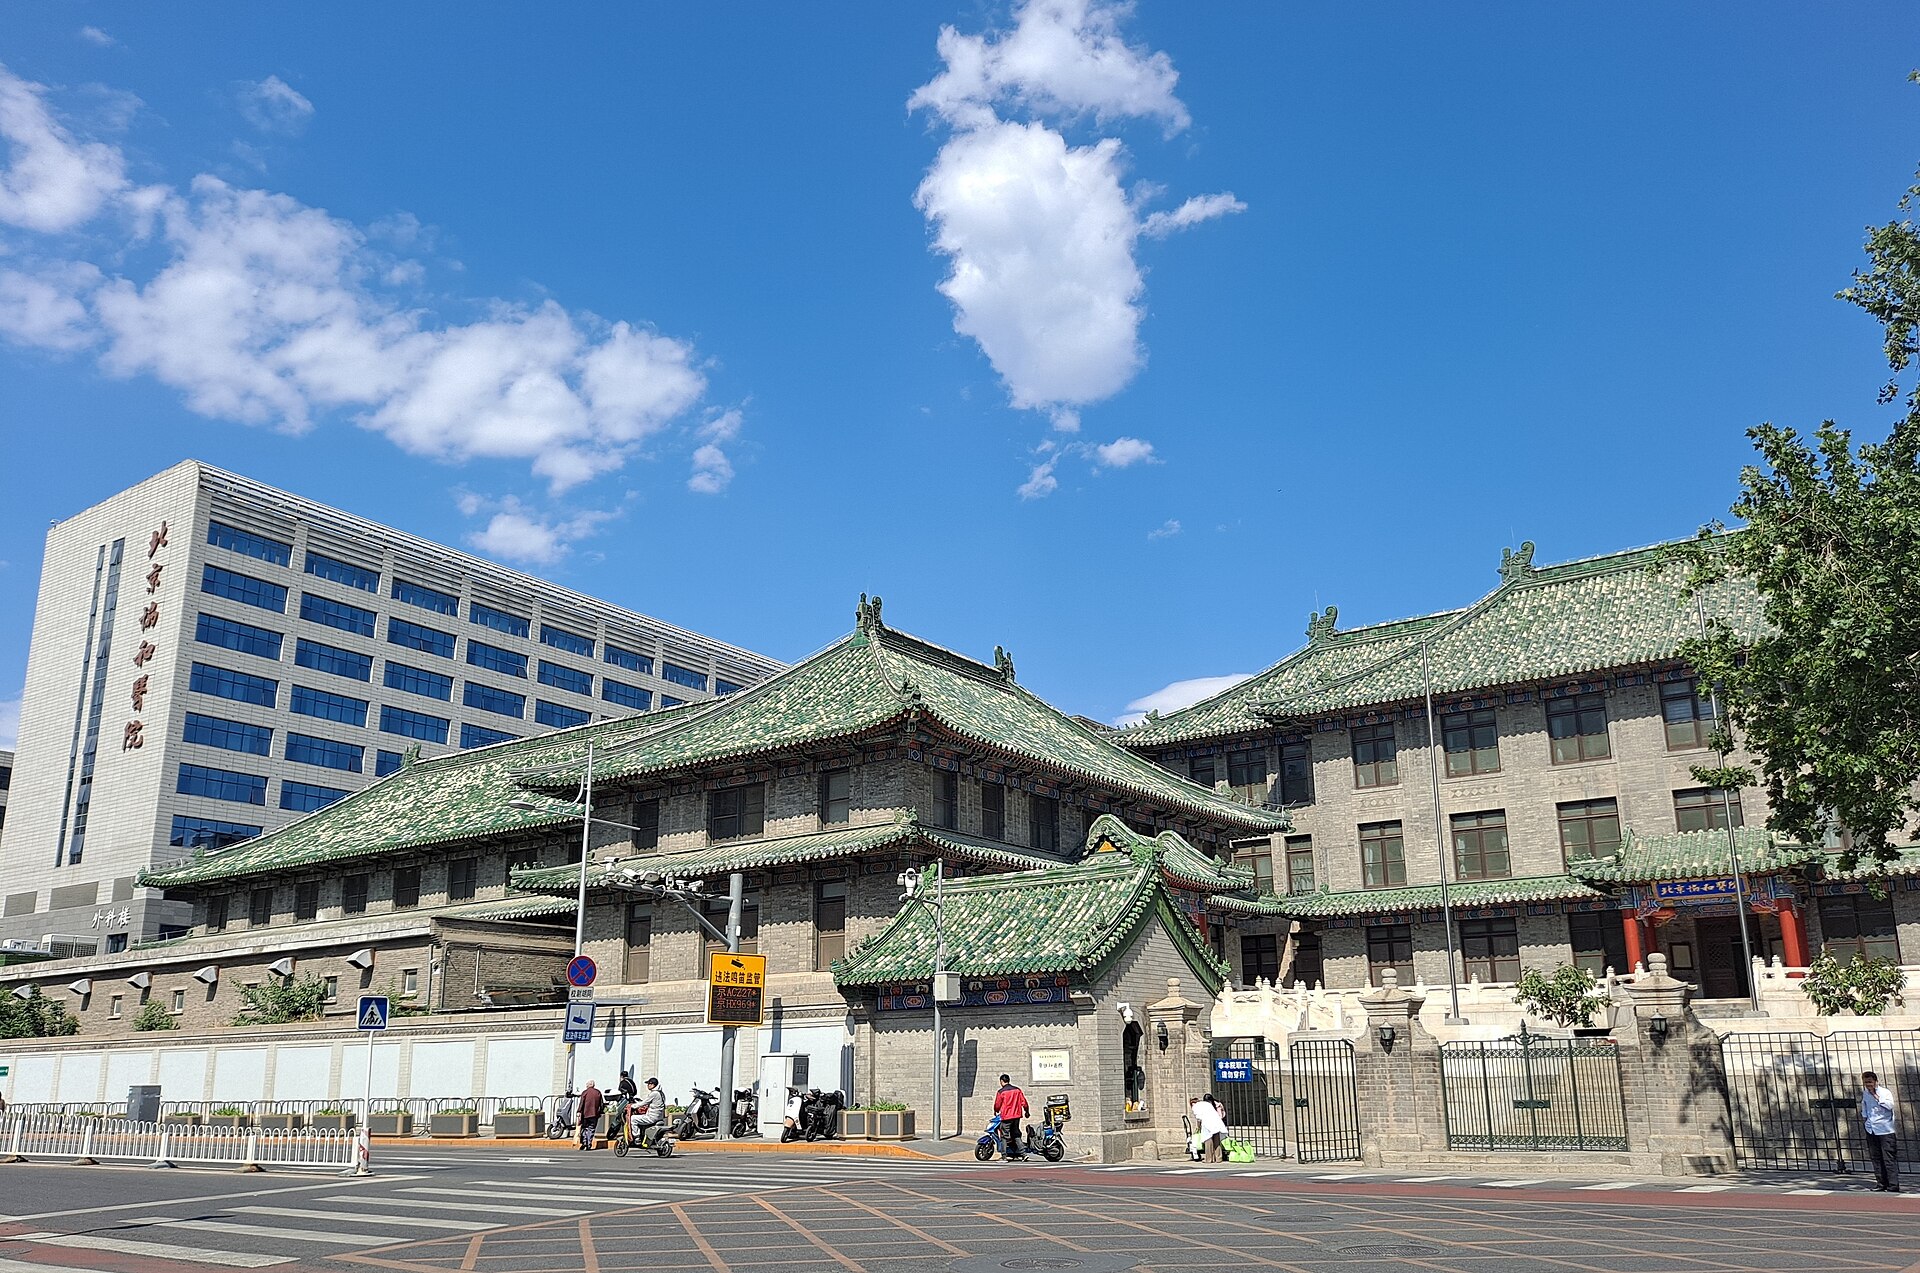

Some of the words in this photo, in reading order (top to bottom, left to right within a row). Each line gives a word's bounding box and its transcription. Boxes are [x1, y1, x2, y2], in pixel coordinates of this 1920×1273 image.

[91, 906, 131, 930] 外科楼
[715, 971, 761, 984] 违法鸣笛监管
